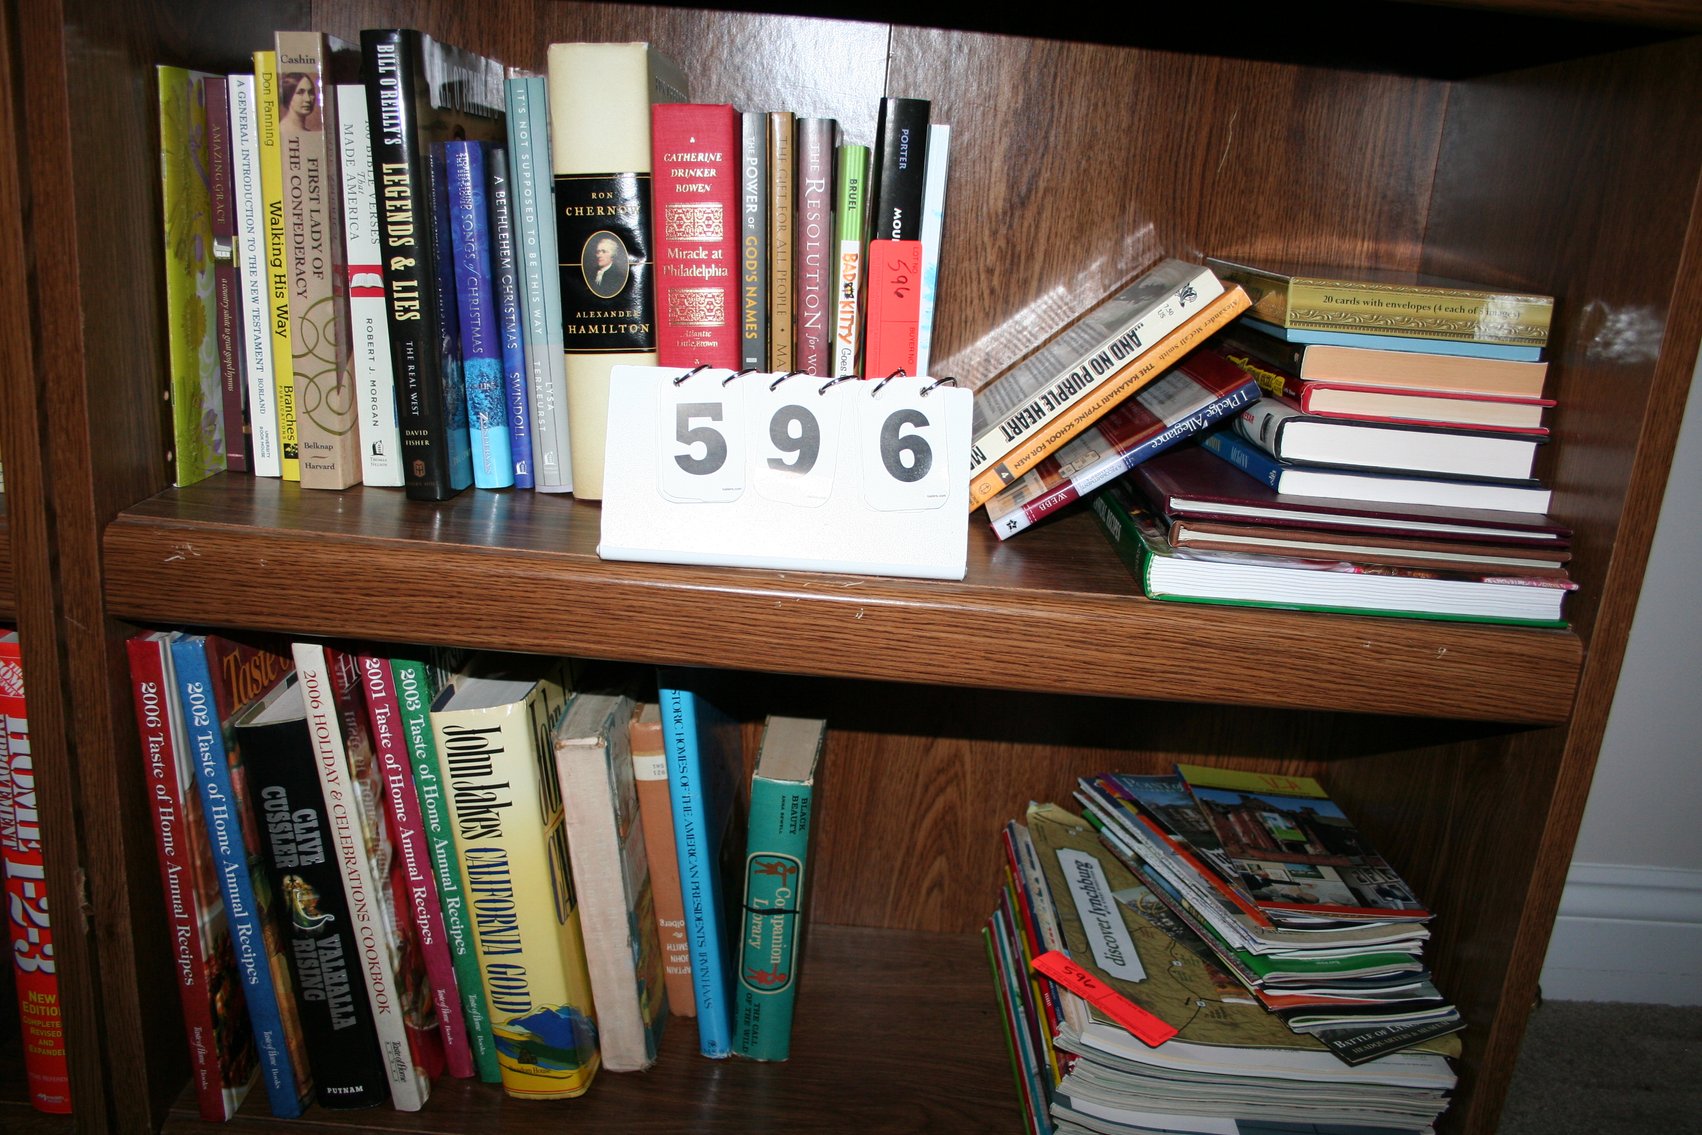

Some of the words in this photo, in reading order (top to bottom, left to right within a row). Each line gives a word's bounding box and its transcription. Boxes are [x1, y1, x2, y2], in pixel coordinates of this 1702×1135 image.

[280, 53, 317, 66] Cashin
[376, 44, 395, 74] BILL
[236, 80, 244, 88] A
[262, 72, 273, 96] Don
[238, 91, 249, 146] GENERAL
[262, 100, 276, 146] Fanning
[518, 121, 528, 148] NOT
[212, 124, 223, 181] AMAZING
[288, 136, 302, 171] THE
[344, 123, 354, 167] MADE
[664, 152, 723, 162] CATHERINE
[746, 136, 755, 154] THE
[899, 128, 910, 169] PORTER
[240, 148, 254, 234] INTRODUCTION
[307, 158, 320, 203] FIRST
[522, 154, 534, 223] SUPPOSED
[671, 169, 717, 178] DRINKER
[676, 184, 712, 192] BOWEN
[746, 156, 758, 214] POWER
[848, 178, 858, 210] BRUEL
[346, 173, 360, 241] AMERICA
[382, 162, 414, 246] LEGENDS
[748, 216, 755, 228] OF
[247, 238, 256, 252] TO
[270, 200, 287, 268] Walking
[290, 176, 308, 299] CONFEDERACY
[310, 209, 322, 254] LADY
[461, 214, 476, 260] SONGS
[495, 190, 511, 269] BETHLEHEM
[527, 229, 536, 245] TO
[776, 234, 788, 264] ALL
[248, 255, 258, 276] THE
[312, 258, 324, 280] OF
[528, 253, 538, 267] BE
[663, 263, 728, 280] Philadelphia
[667, 246, 708, 259] Miracle
[712, 249, 722, 259] at
[746, 235, 758, 282] GOD'S
[804, 176, 826, 330] RESOLUTION
[842, 252, 858, 281] BAD
[250, 280, 260, 304] NEW
[274, 273, 287, 298] His
[530, 274, 540, 302] THIS
[776, 268, 788, 315] PEOPLE
[888, 259, 912, 298] 596
[276, 304, 289, 338] Way
[392, 280, 422, 322] LIES
[467, 276, 484, 354] CHRISTMAS
[501, 274, 518, 349] CHRISTMAS
[532, 309, 542, 335] WAY
[576, 310, 641, 318] ALEXANDER
[746, 286, 758, 339] NAMES
[838, 300, 857, 344] KITTY
[1335, 297, 1360, 306] cards
[1362, 298, 1384, 307] with
[1386, 302, 1432, 312] envelopes
[1444, 304, 1465, 314] each
[1468, 306, 1478, 314] of
[252, 308, 264, 372] TESTAMENT
[366, 318, 376, 361] ROBERT
[568, 323, 650, 334] HAMILTON
[806, 333, 820, 350] for
[369, 366, 376, 375] J.
[406, 341, 414, 360] THE
[1139, 363, 1156, 377] THE
[258, 378, 266, 414] BORLAND
[408, 364, 417, 390] REAL
[534, 360, 546, 432] TERKEURST
[544, 382, 554, 411] LYSA
[1038, 364, 1096, 412] PURPLE
[1102, 374, 1140, 405] KALAHARI
[284, 385, 296, 441] Branches
[370, 380, 380, 426] MORGAN
[410, 392, 419, 416] WEST
[510, 372, 524, 440] SWINDOLL
[998, 400, 1048, 443] HEART
[1074, 402, 1102, 425] TYPING
[1206, 392, 1241, 418] Pledge
[1032, 442, 1048, 456] FOR
[1048, 422, 1075, 444] SCHOOL
[1151, 413, 1208, 449] Allegiance
[304, 462, 336, 470] Harvard
[1014, 454, 1032, 470] MEN
[1039, 492, 1068, 511] WEBB
[303, 670, 324, 709] 2006
[364, 658, 386, 700] 2001
[400, 668, 420, 712] 2003
[140, 682, 160, 728] 2006
[186, 682, 210, 726] 2002
[373, 704, 393, 749] Taste
[408, 714, 428, 759] Taste
[148, 732, 164, 778] Taste
[196, 730, 216, 777] Taste
[312, 713, 341, 787] HOLIDAY
[384, 754, 400, 771] of
[442, 724, 505, 778] John
[674, 732, 690, 774] HOMES
[156, 784, 172, 804] of
[208, 783, 224, 803] of
[418, 764, 435, 782] of
[680, 775, 691, 791] OF
[388, 774, 408, 822] Home
[422, 784, 442, 832] Home
[452, 780, 512, 841] Jakes
[788, 794, 800, 836] BEAUTY
[798, 798, 809, 832] BLACK
[158, 806, 176, 857] Home
[212, 804, 232, 855] Home
[261, 784, 300, 869] CUSSLER
[292, 808, 326, 867] CLIVE
[332, 804, 370, 922] CELEBRATIONS
[399, 826, 422, 880] Annual
[434, 836, 458, 891] Annual
[684, 818, 699, 878] AMERICAN
[166, 860, 190, 919] Annual
[222, 860, 248, 918] Annual
[464, 847, 524, 955] CALIFORNIA
[1074, 859, 1112, 918] lynchburg
[412, 886, 434, 946] Recipes
[444, 896, 466, 956] Recipes
[690, 881, 706, 948] PRESIDENTS
[176, 924, 196, 986] Recipes
[236, 922, 260, 985] Recipes
[1096, 917, 1126, 967] discover
[290, 938, 326, 1000] RISING
[316, 933, 357, 1030] VALHALLA
[360, 926, 390, 1015] COOKBOOK
[699, 952, 710, 980] IRVIN
[1064, 965, 1096, 989] 596
[28, 990, 56, 1004] NEW
[486, 963, 532, 1015] GOLD
[746, 992, 754, 1004] OF
[744, 1007, 753, 1025] THE
[752, 1002, 761, 1022] THE
[742, 1030, 752, 1053] WILD
[751, 1024, 760, 1046] CALL
[1332, 1031, 1372, 1049] BATTLE
[1374, 1030, 1388, 1038] OF
[327, 1085, 364, 1094] PUTNAM
